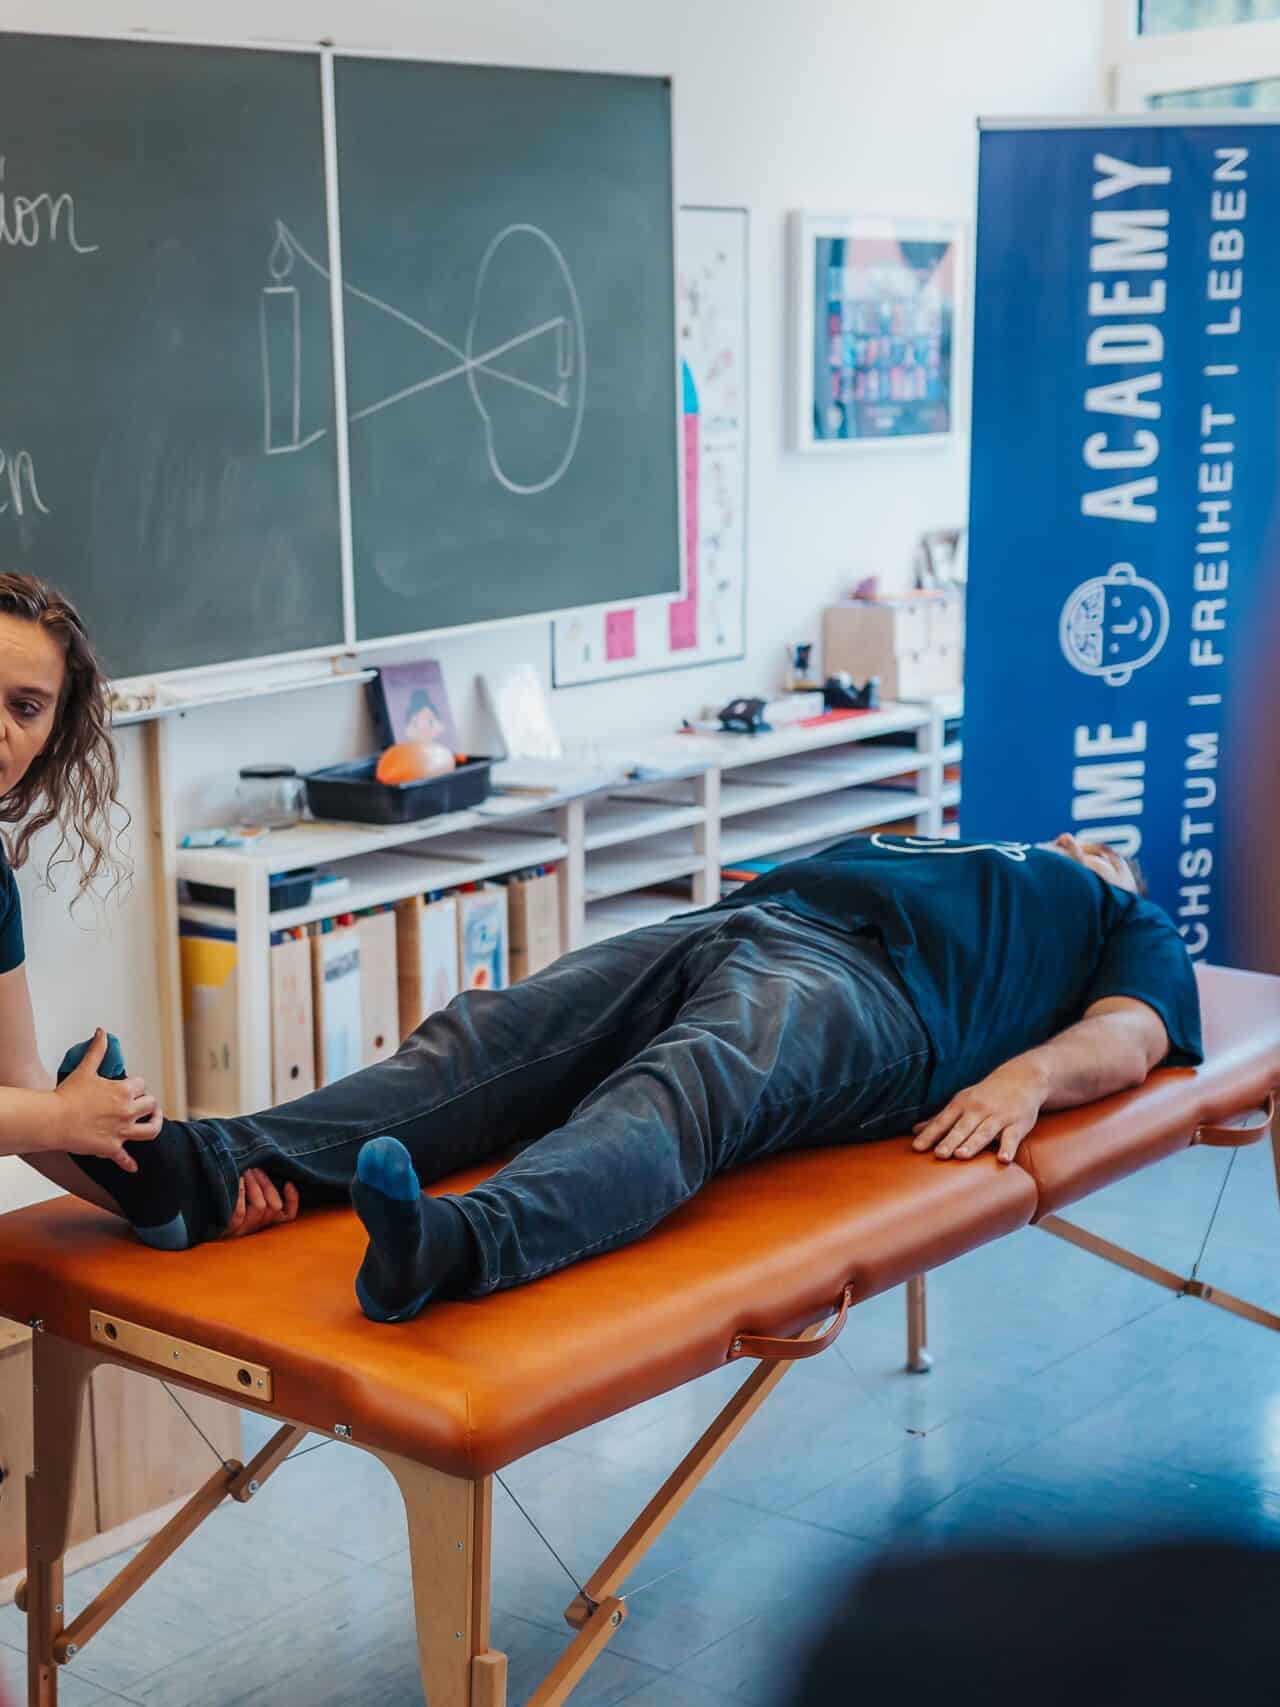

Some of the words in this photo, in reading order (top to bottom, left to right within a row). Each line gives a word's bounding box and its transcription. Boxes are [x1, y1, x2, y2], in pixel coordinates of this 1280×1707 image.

[1081, 152, 1172, 523] ACADEMY
[1206, 147, 1249, 335] LEBEN
[1189, 403, 1236, 666] FREIHEIT
[1177, 731, 1219, 966] CHSTUM
